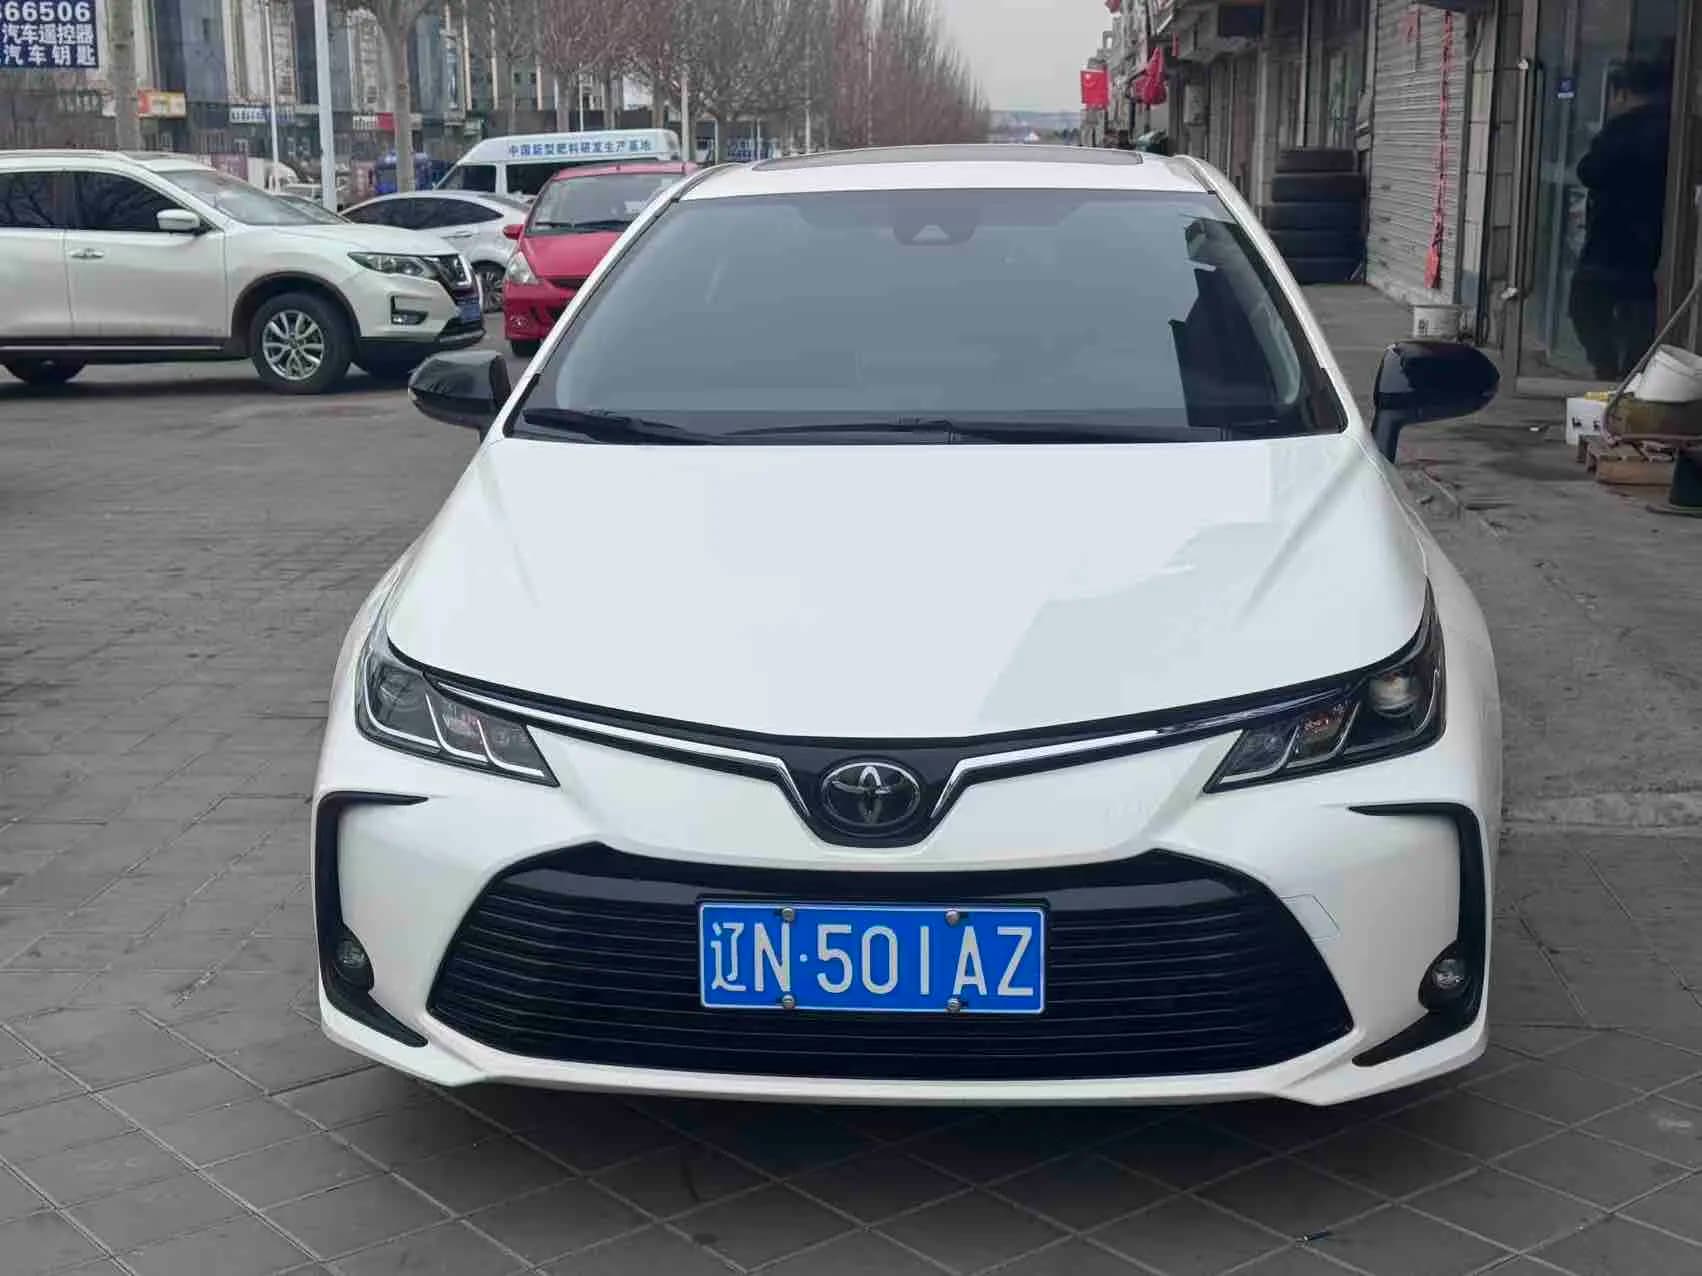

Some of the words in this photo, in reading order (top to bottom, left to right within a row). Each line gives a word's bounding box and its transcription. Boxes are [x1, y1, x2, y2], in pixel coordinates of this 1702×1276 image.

[0, 1, 91, 21] 66506
[1, 23, 94, 44] 汽车遥控器
[0, 44, 96, 65] 汽车钥匙
[710, 922, 1034, 996] 辽N·501AZ
